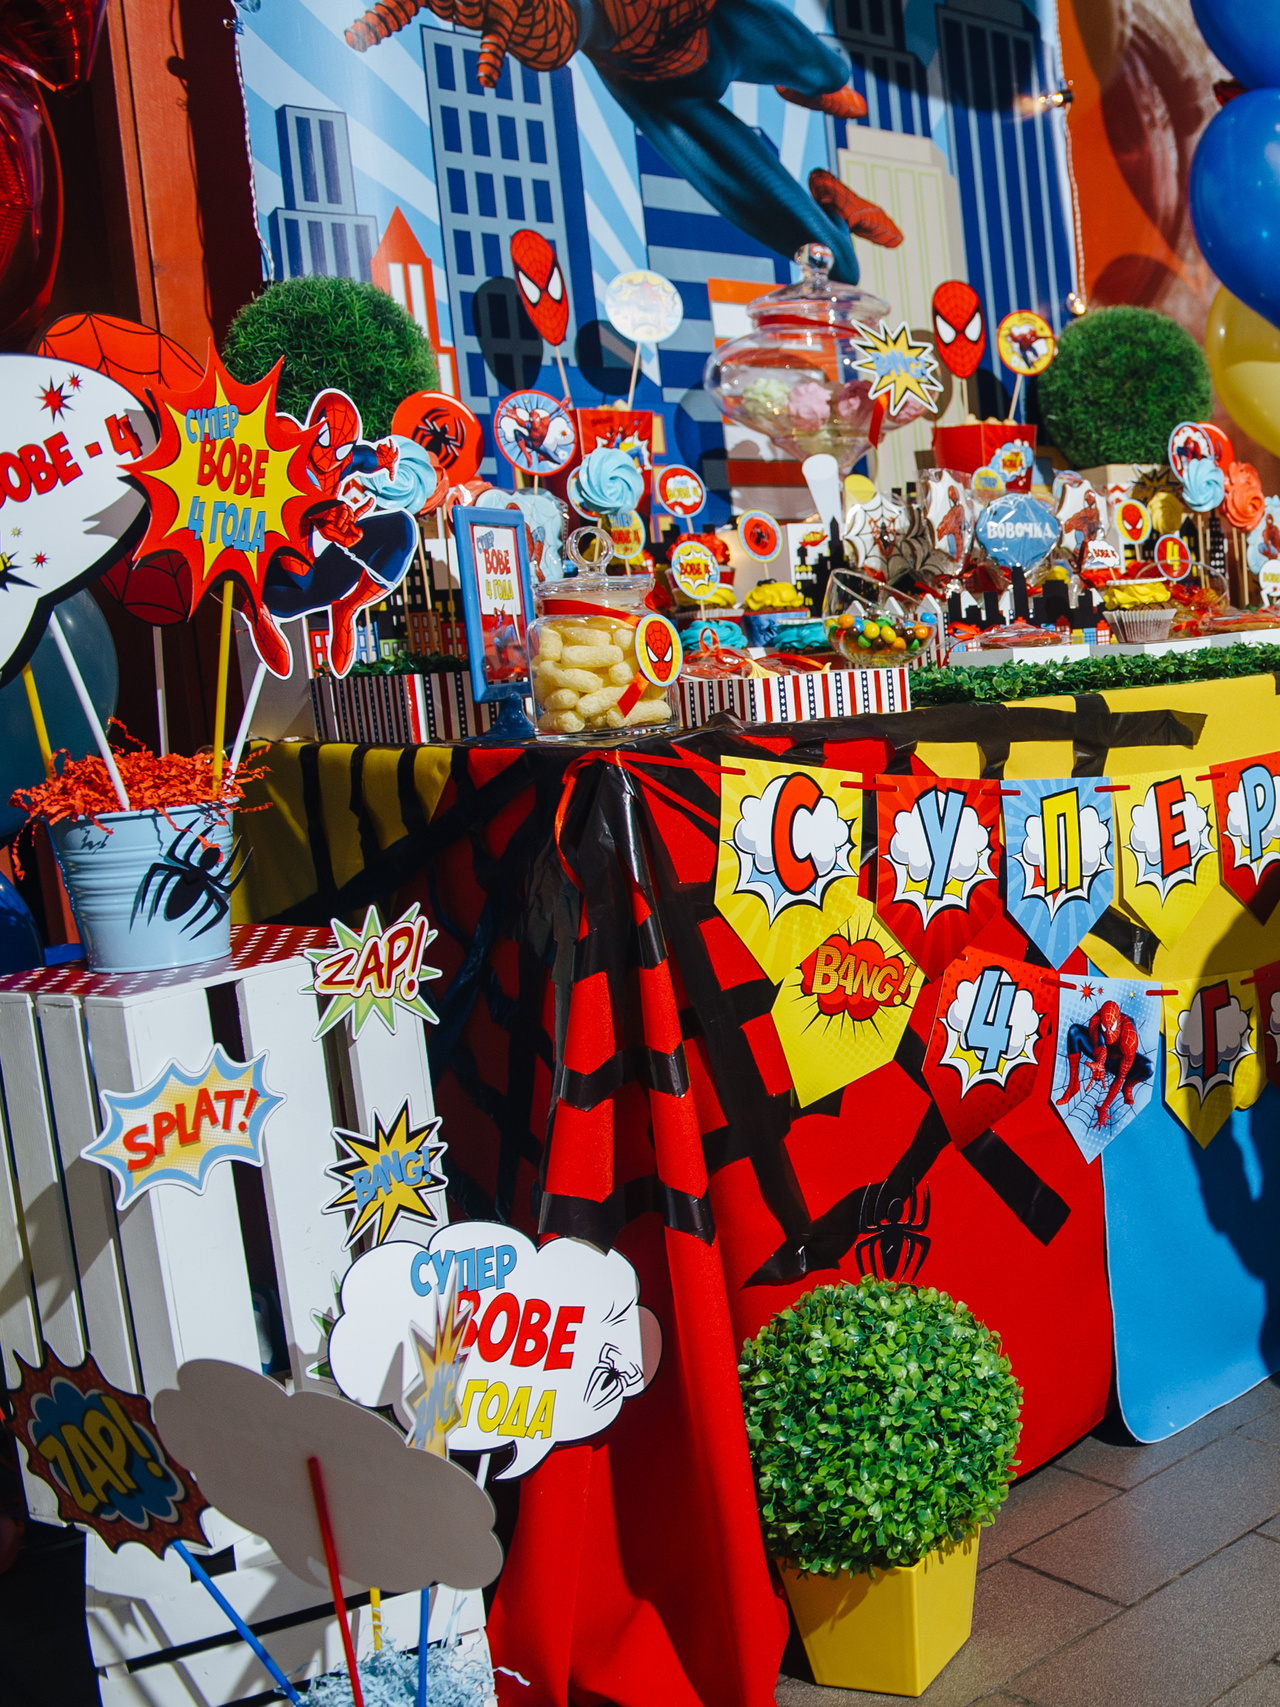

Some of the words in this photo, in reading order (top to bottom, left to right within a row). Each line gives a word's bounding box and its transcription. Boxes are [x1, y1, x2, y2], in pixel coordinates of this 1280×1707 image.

[872, 350, 927, 382] BANG!
[185, 404, 239, 444] СУПЕР
[0, 431, 83, 509] ОВЕ
[104, 414, 143, 460] 4
[197, 432, 270, 499] ВОВЕ
[187, 496, 206, 540] 4
[208, 501, 266, 553] ГОДА
[987, 520, 1051, 540] ВОВОЧКА
[483, 548, 511, 575] ВОВЕ
[1166, 540, 1181, 571] 4
[313, 914, 429, 1002] ZAP!
[811, 944, 919, 1007] BANG!
[122, 1086, 260, 1171] SPLAT!
[353, 1146, 435, 1210] BANG!
[411, 1244, 518, 1297] СУПЕР
[460, 1379, 557, 1440] ГОДА
[39, 1396, 165, 1515] ZAP!
